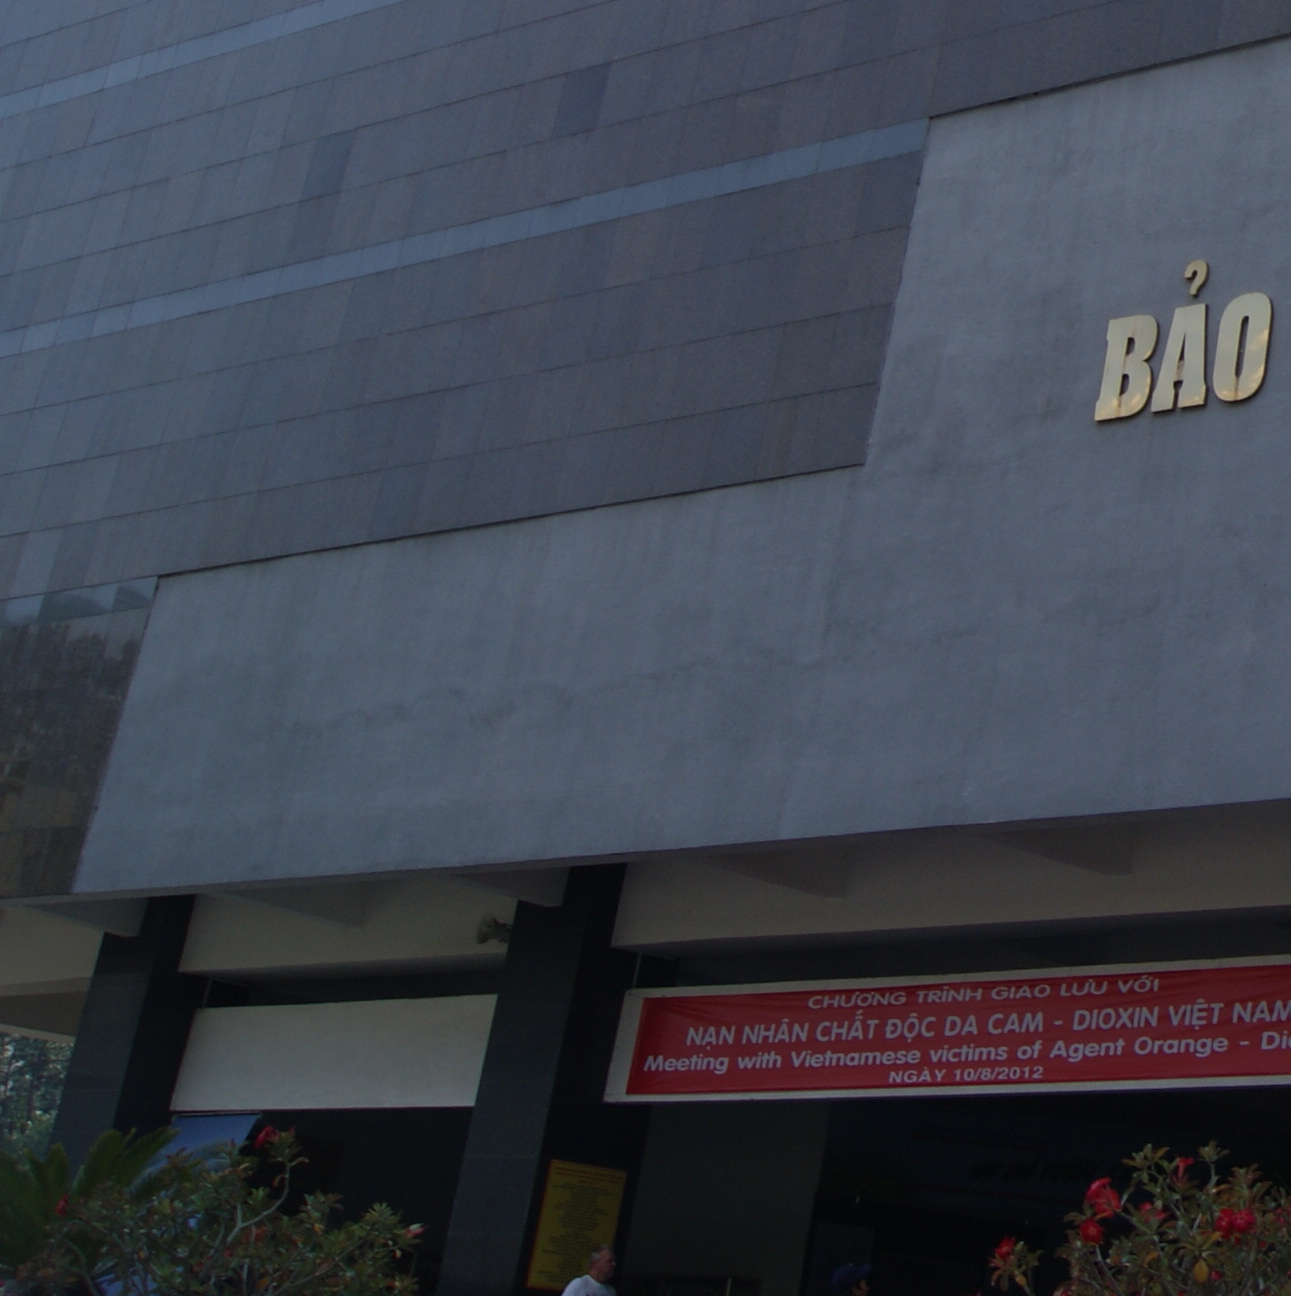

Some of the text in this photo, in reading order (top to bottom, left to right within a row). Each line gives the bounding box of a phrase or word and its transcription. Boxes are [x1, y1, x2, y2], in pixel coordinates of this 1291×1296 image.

[1094, 260, 1272, 422] BẢO
[808, 975, 1160, 1009] CHƯƠNG TRÌNH GIAO LƯU VỚI
[686, 1025, 736, 1050] NẠN
[741, 1018, 809, 1044] NHÂN
[816, 1010, 879, 1042] CHẤT
[885, 1012, 937, 1043] ĐỘC
[944, 1014, 978, 1037] DA
[987, 1012, 1044, 1035] CAM
[1072, 1006, 1159, 1031] DIOXIN
[1168, 998, 1225, 1031] VIỆT
[643, 1053, 729, 1075] Meeting
[737, 1050, 782, 1069] with
[790, 1049, 921, 1067] Vietnamese
[930, 1043, 1008, 1062] victims
[1017, 1039, 1044, 1060] of
[1049, 1038, 1125, 1063] Agent
[1134, 1035, 1229, 1058] Orange
[888, 1065, 1044, 1084] NGÀY 10/8/2012
